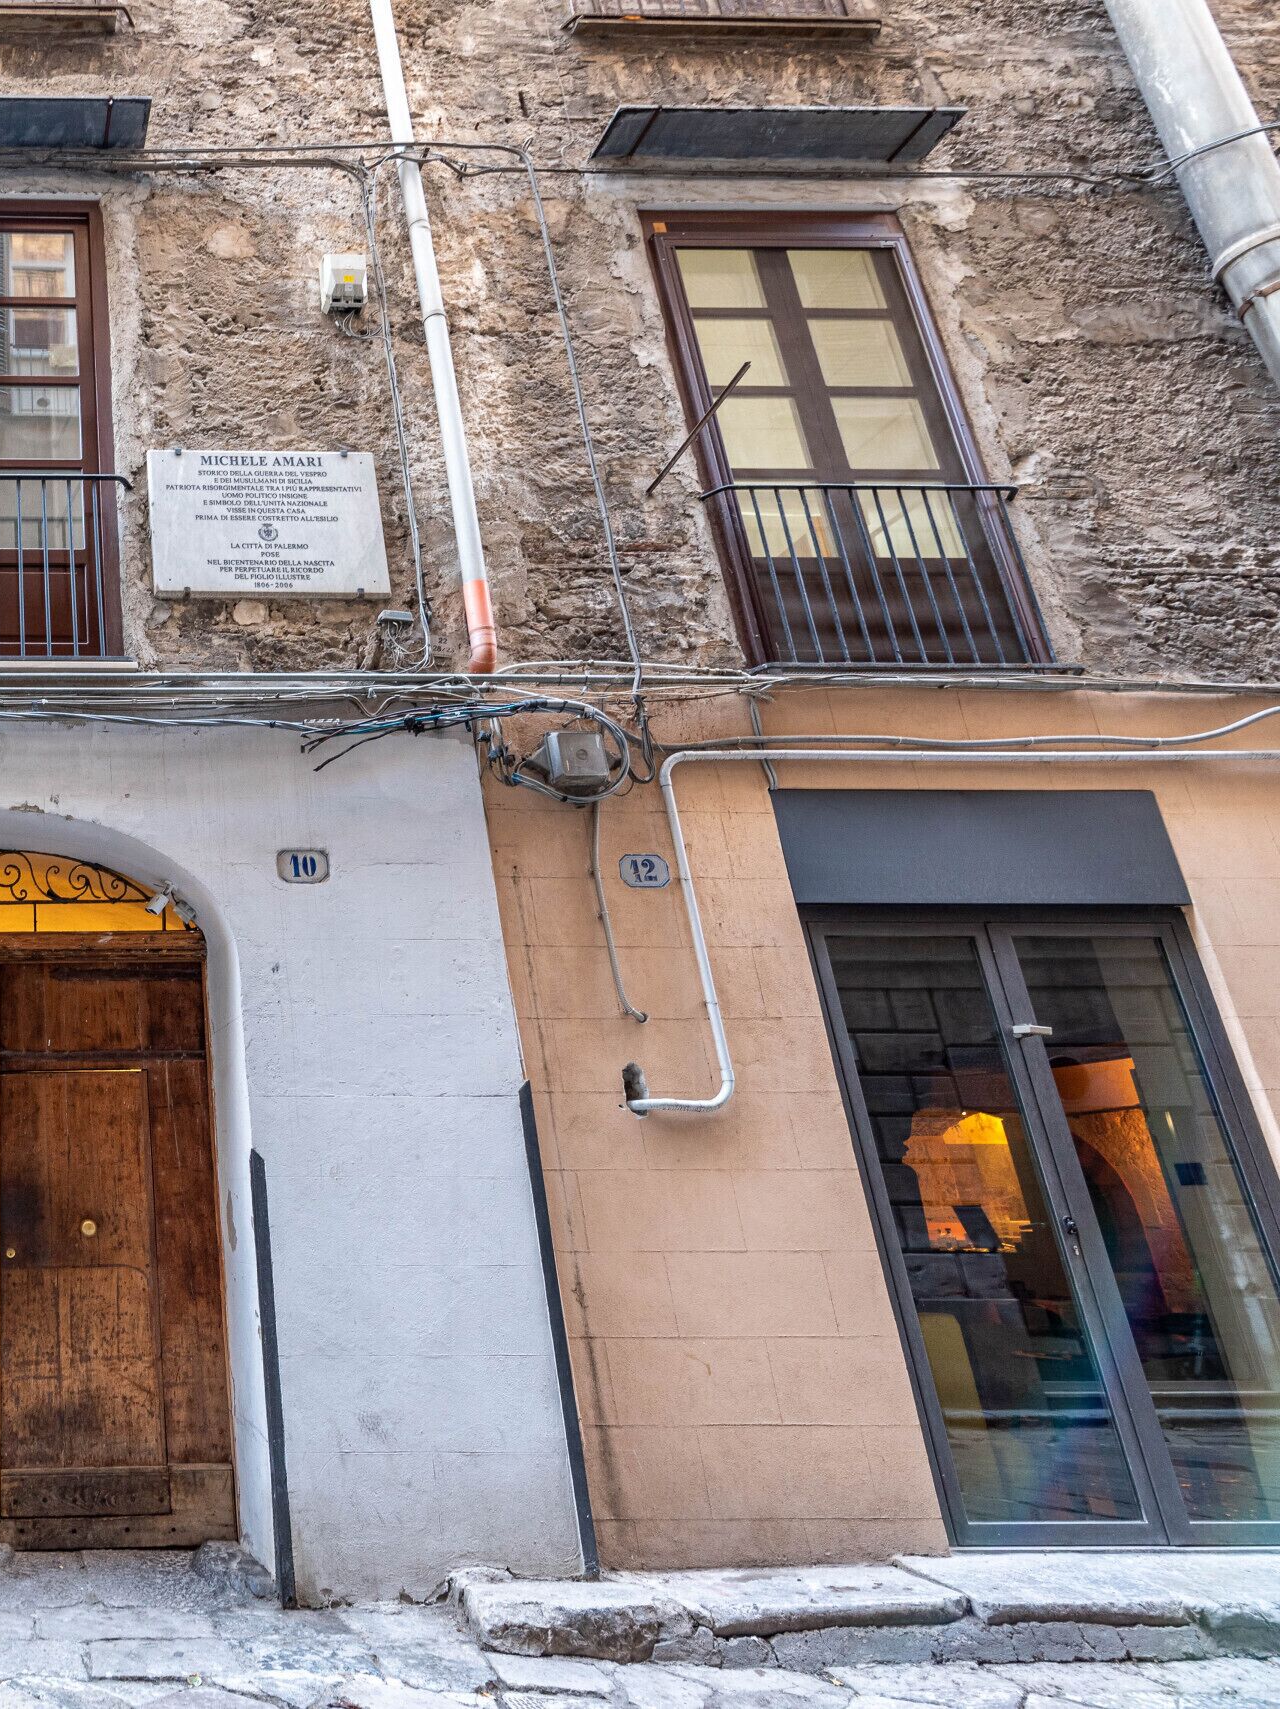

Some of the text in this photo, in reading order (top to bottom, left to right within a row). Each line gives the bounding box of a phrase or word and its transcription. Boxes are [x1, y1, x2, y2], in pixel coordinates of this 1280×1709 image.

[200, 455, 322, 467] MICHELE AMARI
[289, 853, 317, 877] 10
[630, 858, 658, 883] 12
